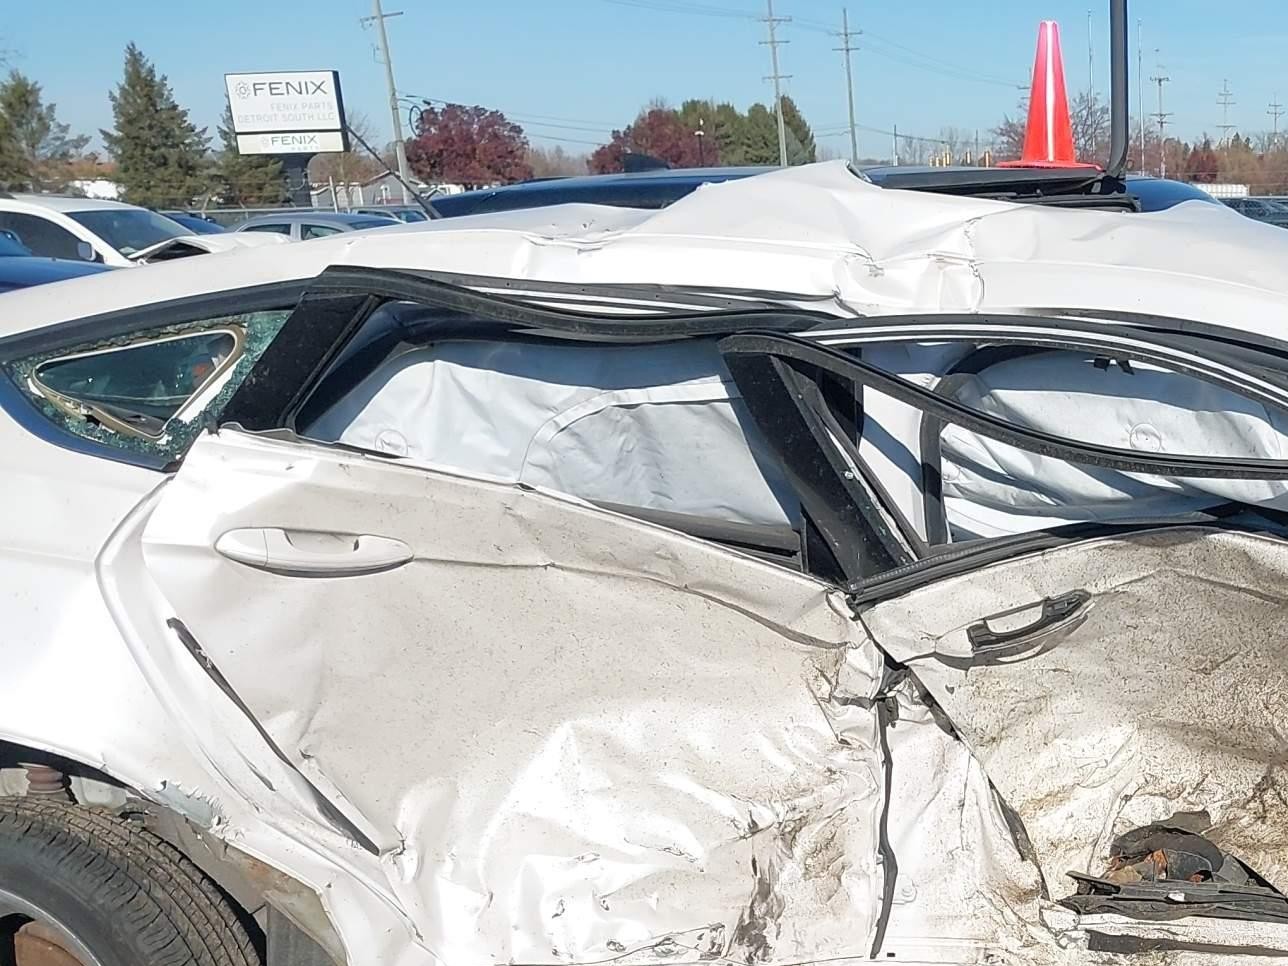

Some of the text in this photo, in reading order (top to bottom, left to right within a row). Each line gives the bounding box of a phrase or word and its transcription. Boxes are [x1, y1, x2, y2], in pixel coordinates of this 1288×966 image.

[252, 80, 328, 96] FENIX
[270, 101, 333, 112] FENIX PARTS
[237, 111, 335, 124] DETROIT SOUTH LLC
[271, 135, 318, 146] FENIX
